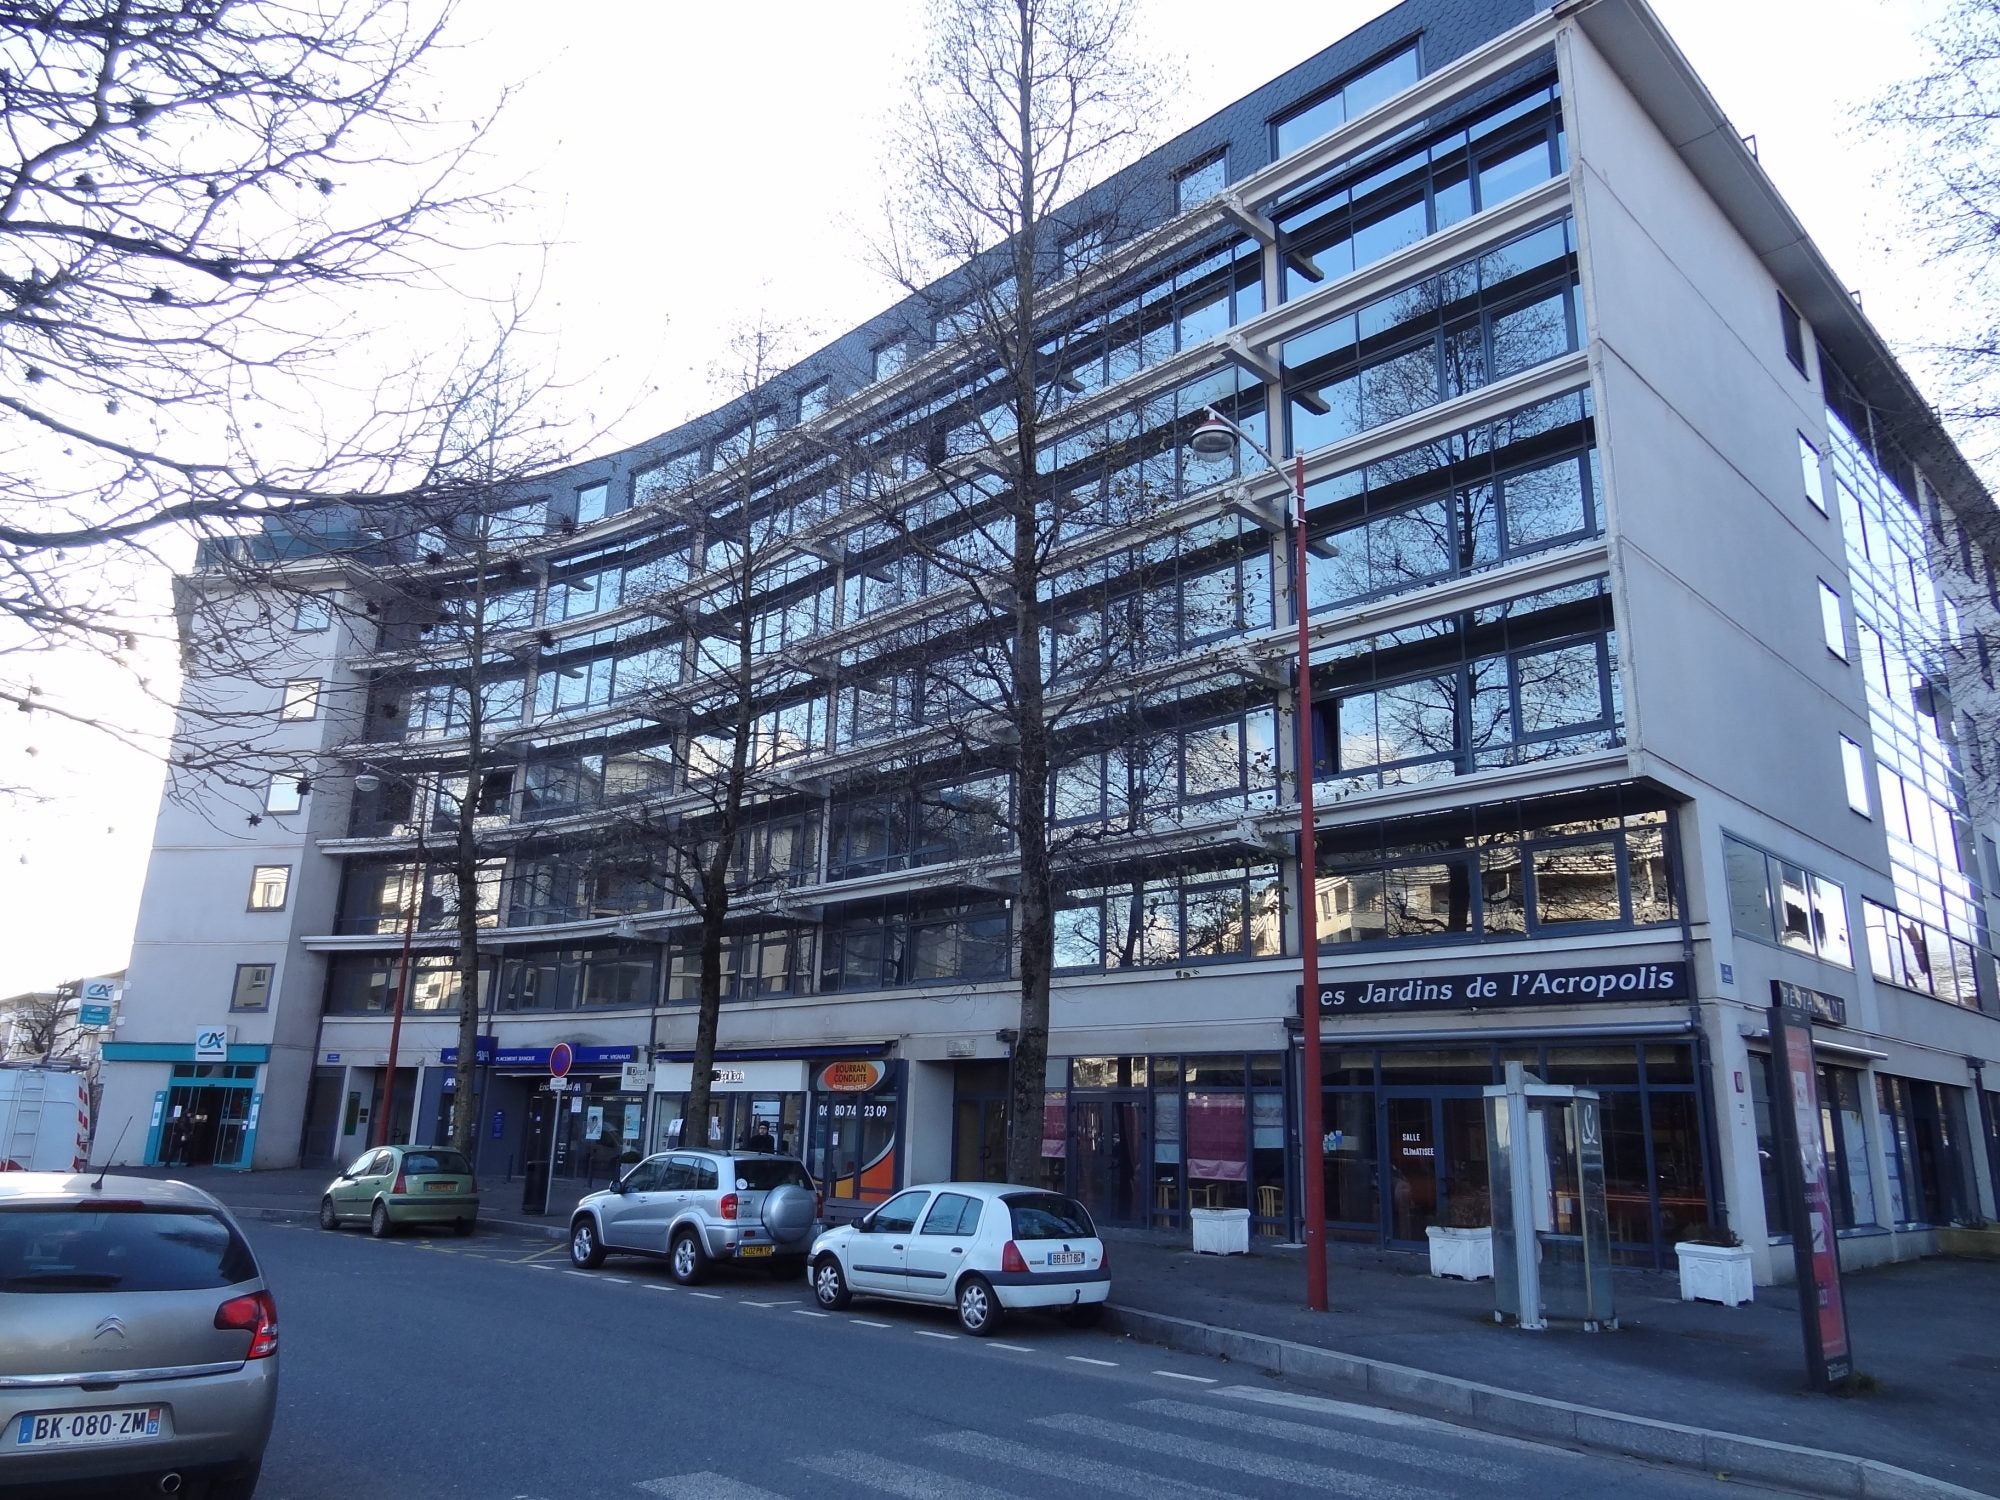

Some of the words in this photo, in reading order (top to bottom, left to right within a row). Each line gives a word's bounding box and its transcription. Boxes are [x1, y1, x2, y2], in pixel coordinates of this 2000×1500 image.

[1320, 989, 1345, 1006] es
[1358, 980, 1453, 1004] Jardins
[1466, 976, 1497, 998] de
[1511, 965, 1674, 998] l'Acropolis
[1783, 987, 1845, 1023] RESTAURANT
[835, 1063, 867, 1073] BOURRAN
[833, 1073, 867, 1083] CONDUITE
[834, 1104, 845, 1116] 80
[846, 1105, 857, 1117] 74
[863, 1105, 874, 1117] 23
[876, 1105, 887, 1117] 09
[1402, 1133, 1421, 1142] SALLE
[148, 1421, 158, 1433] 12
